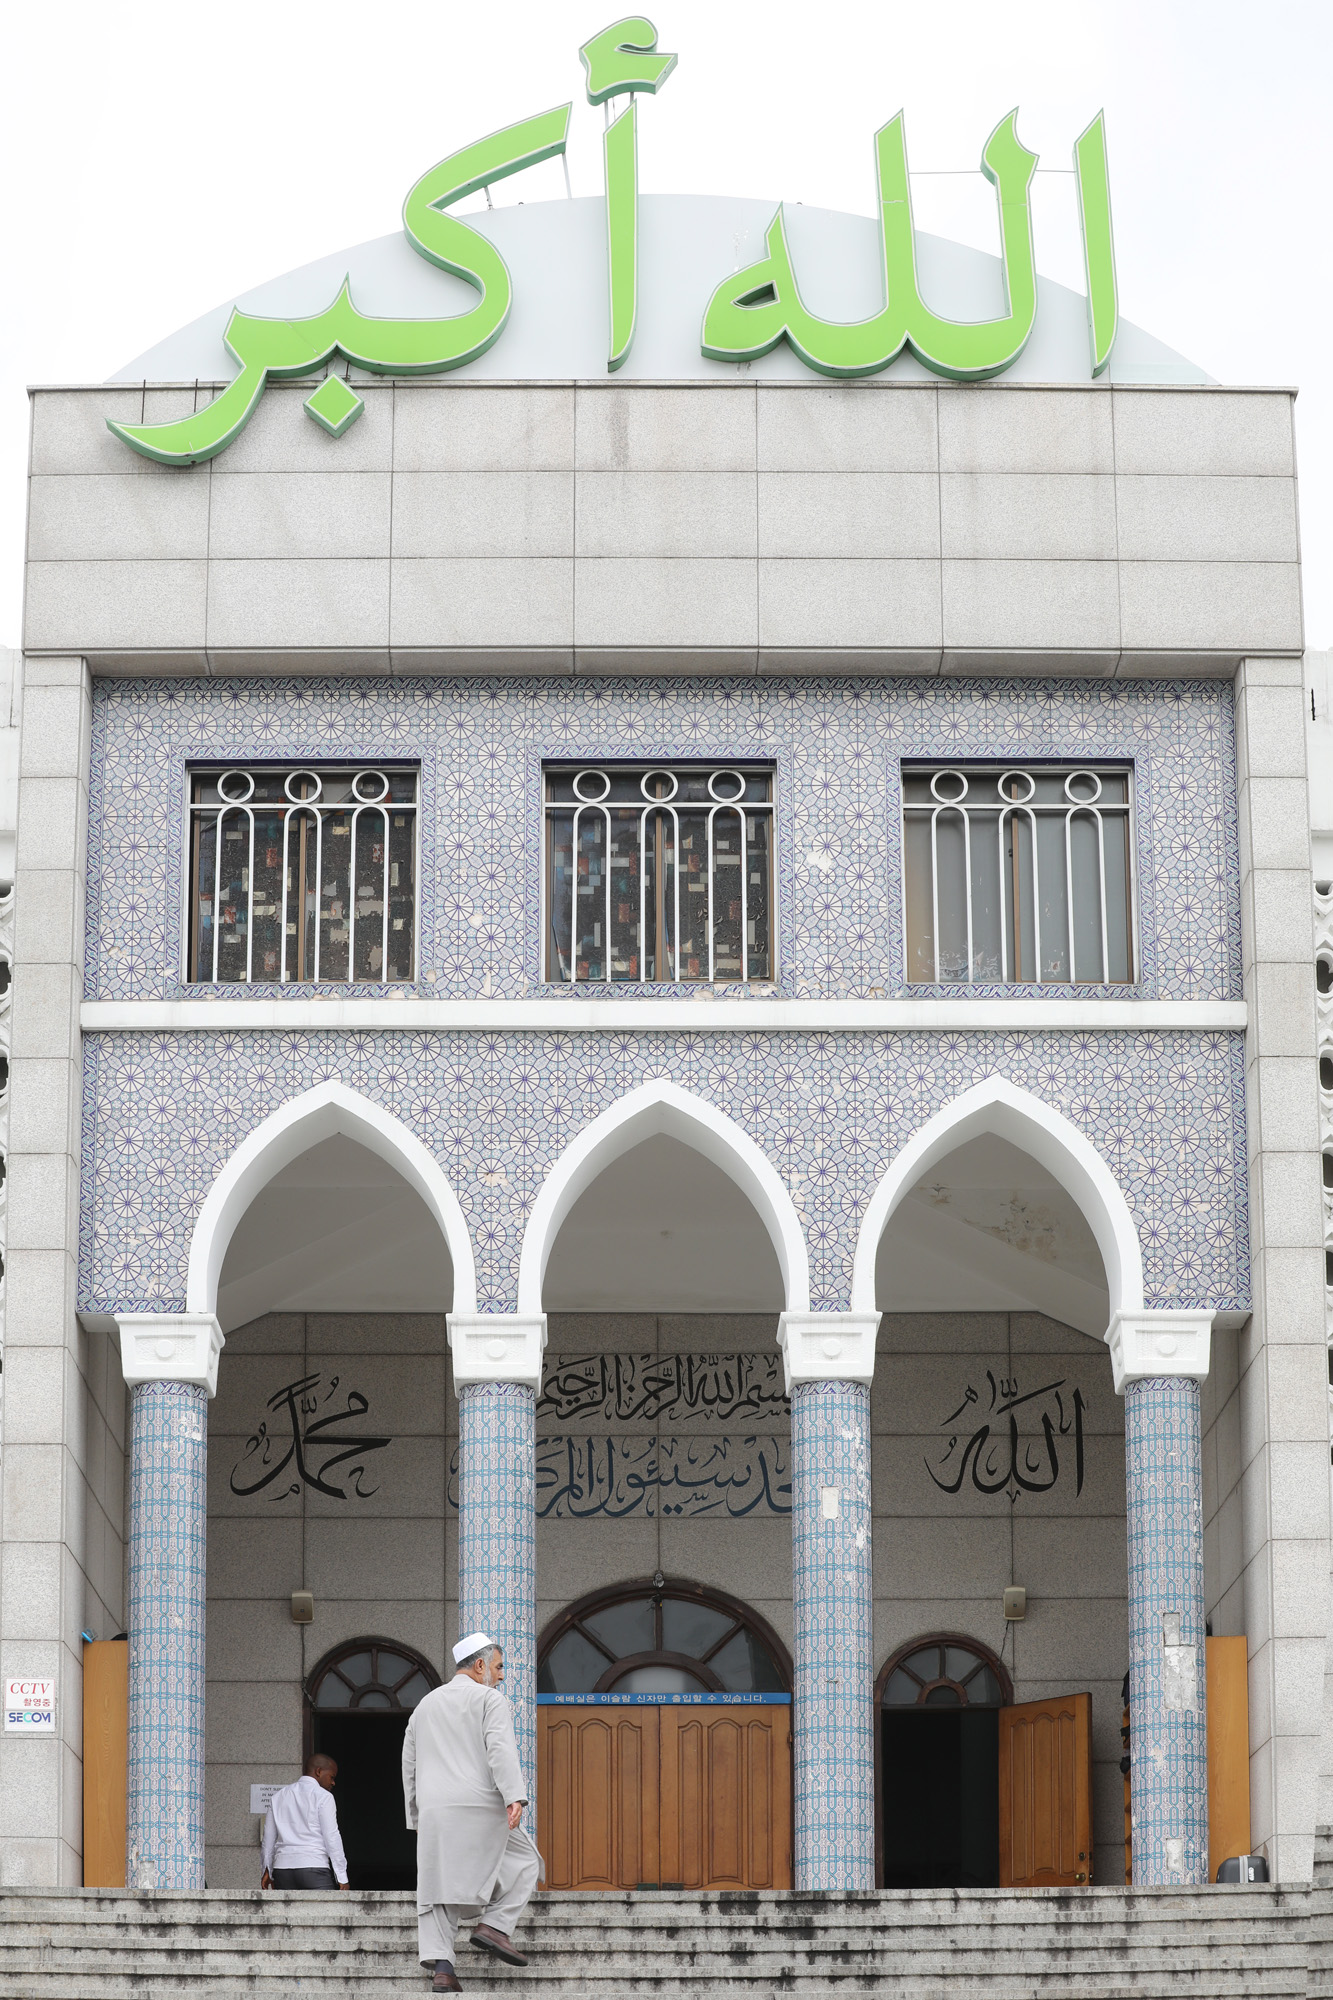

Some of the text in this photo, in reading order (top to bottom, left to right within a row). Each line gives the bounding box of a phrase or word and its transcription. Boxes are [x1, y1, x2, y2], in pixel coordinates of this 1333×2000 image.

[105, 15, 1119, 466] الله أكبر
[10, 1682, 50, 1695] CCTV
[24, 1698, 51, 1707] 촬영중
[555, 1694, 595, 1703] 예배실은
[601, 1694, 631, 1703] 이슬람
[636, 1694, 667, 1703] 신자만
[672, 1694, 702, 1703] 출입할
[707, 1694, 717, 1703] 수
[8, 1711, 51, 1723] SECOM
